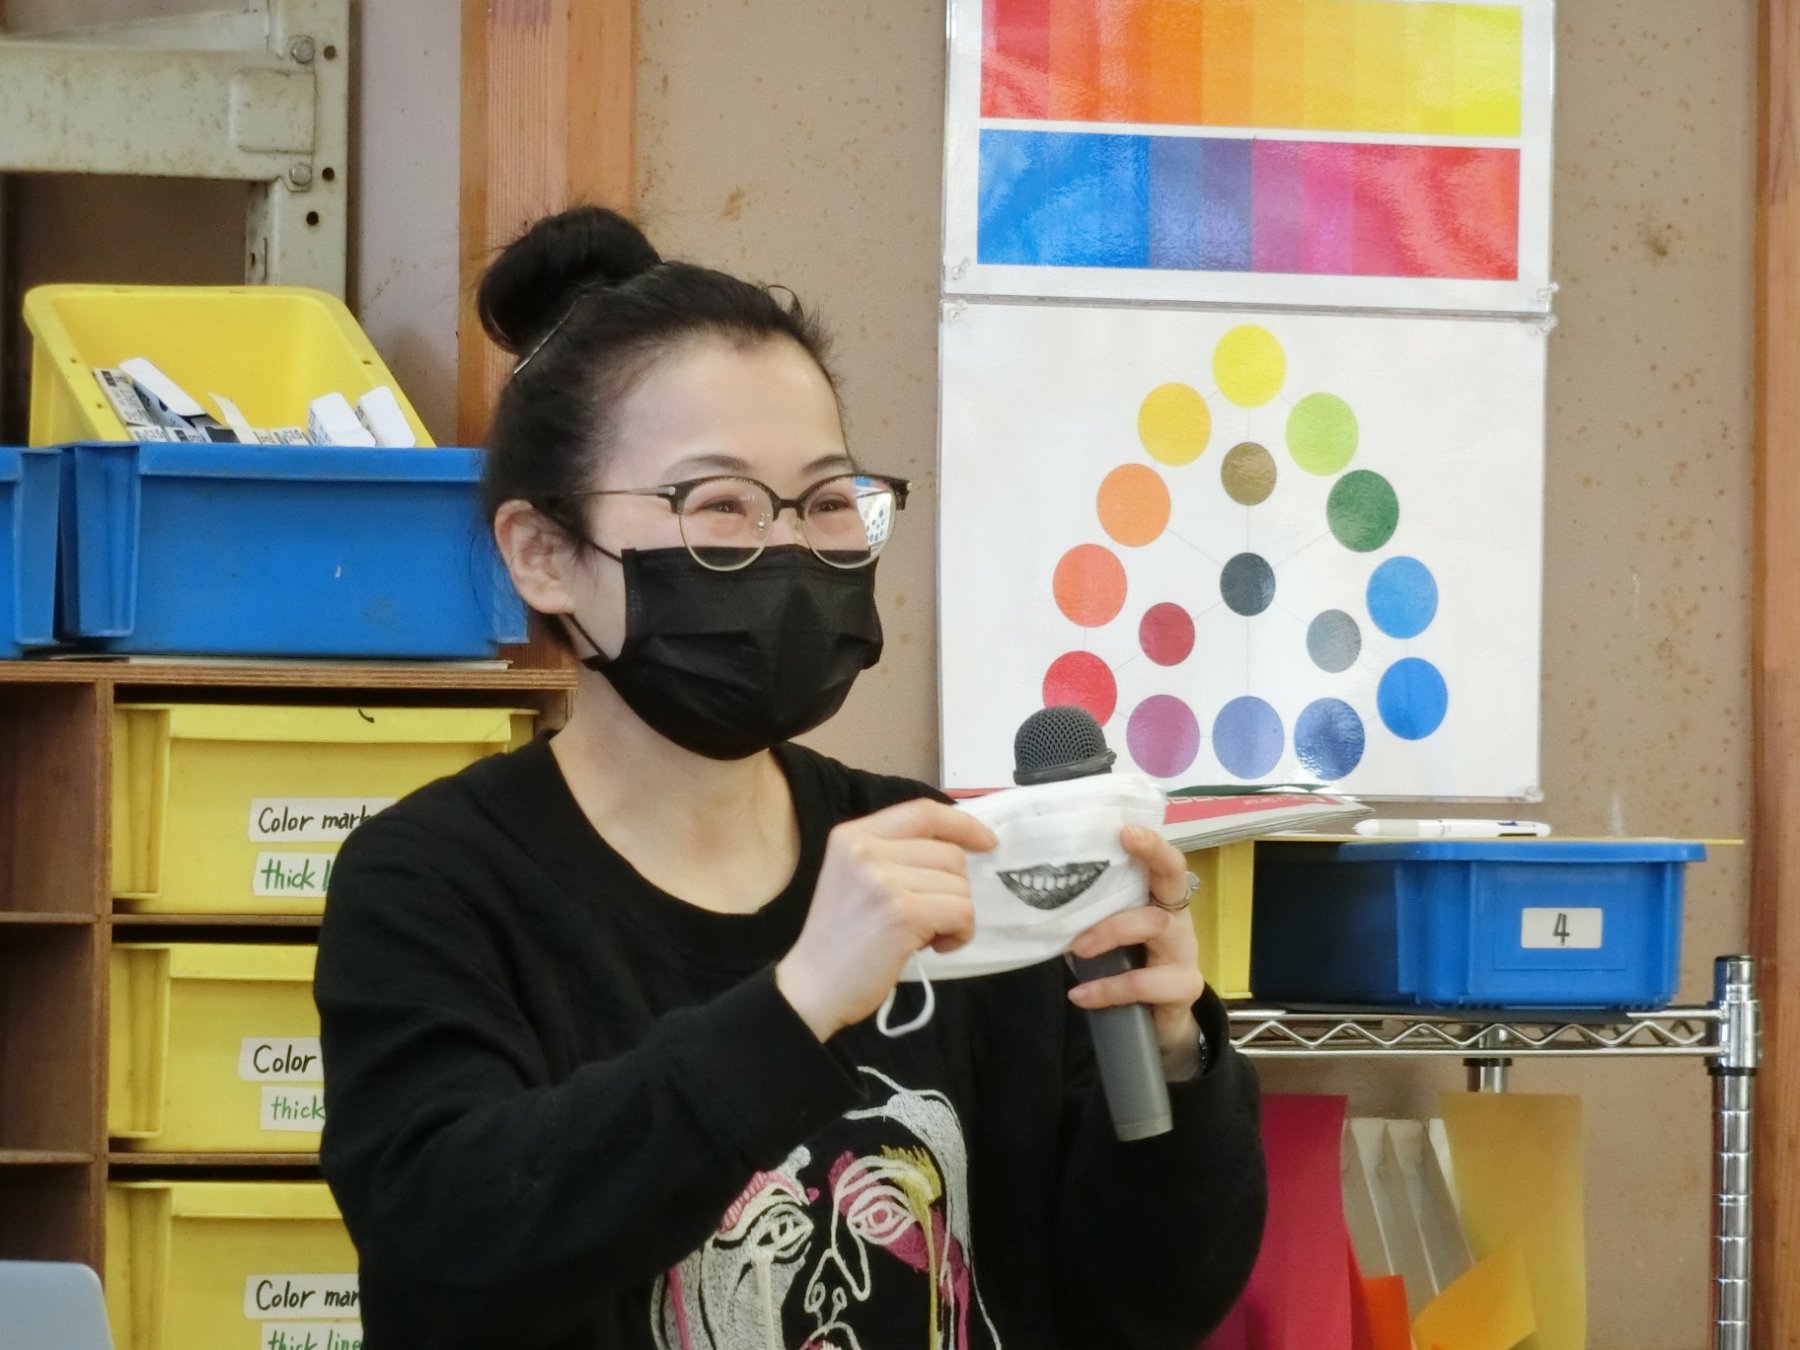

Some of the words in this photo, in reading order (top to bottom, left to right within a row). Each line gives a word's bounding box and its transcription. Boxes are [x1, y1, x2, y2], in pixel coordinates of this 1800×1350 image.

[258, 806, 315, 834] Color
[260, 858, 316, 891] thick
[1552, 912, 1570, 946] 4
[253, 1044, 317, 1074] Color
[271, 1095, 326, 1121] thick
[256, 1280, 316, 1311] Color
